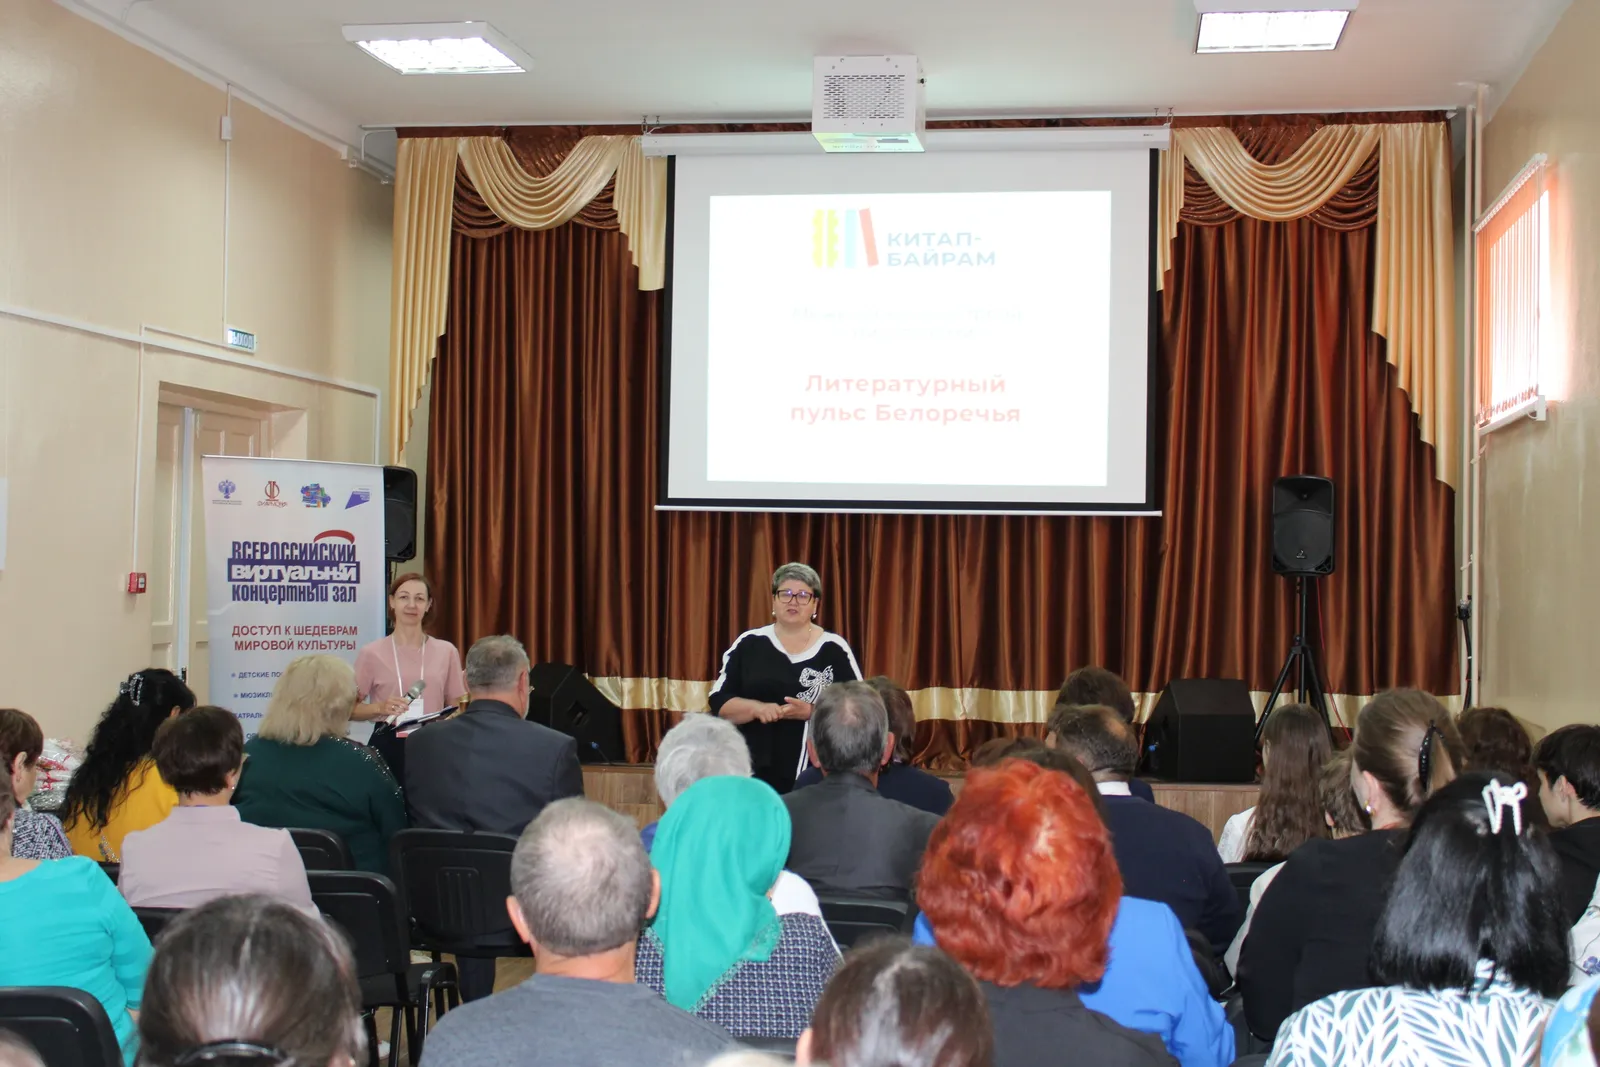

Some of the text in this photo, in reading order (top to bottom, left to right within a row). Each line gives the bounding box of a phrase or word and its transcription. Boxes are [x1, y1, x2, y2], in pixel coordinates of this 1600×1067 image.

[887, 232, 982, 247] КИТАП-
[886, 249, 997, 268] БАЙРАМ
[804, 373, 1006, 397] Литературный
[790, 404, 1021, 426] пульс Белоречья
[232, 625, 357, 637] ДОСТУП К ШЕДЕВРАМ
[234, 638, 356, 650] МИРОВОЙ КУЛЬТУРЫ
[238, 671, 270, 679] ДЕТСКИЕ
